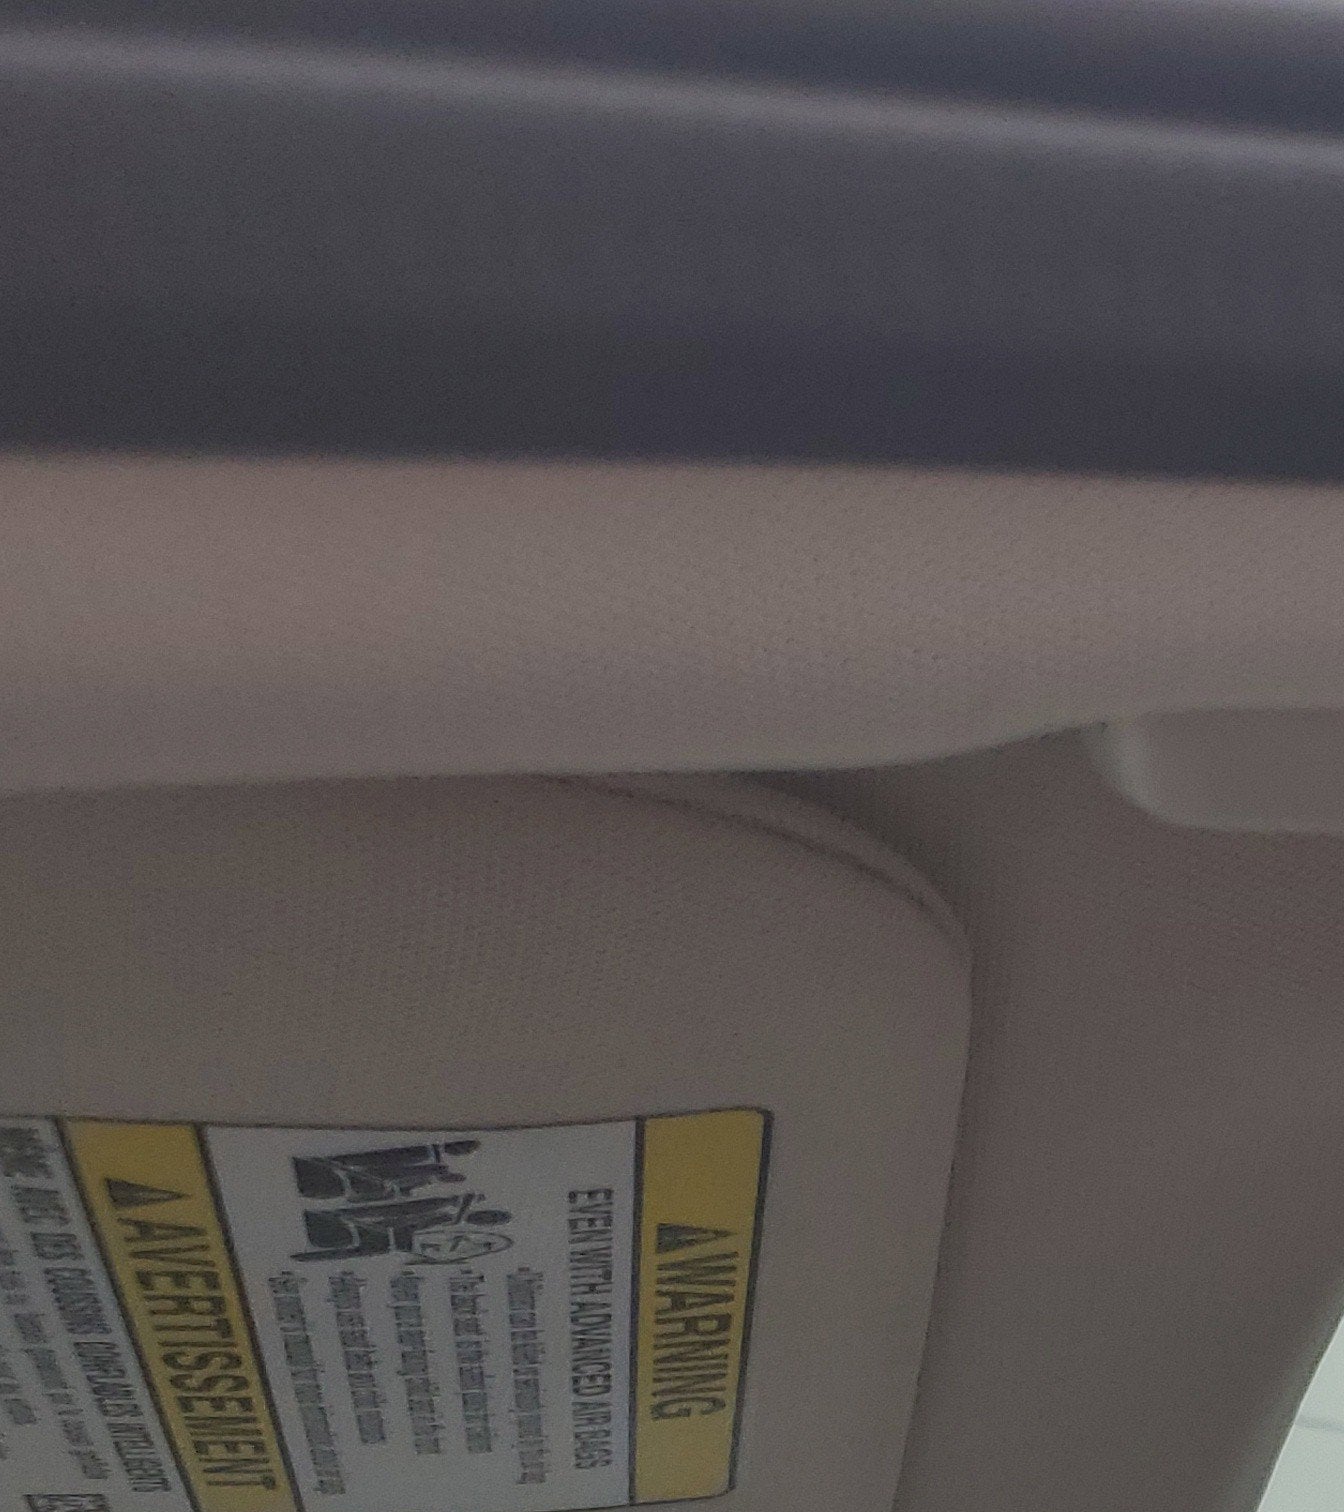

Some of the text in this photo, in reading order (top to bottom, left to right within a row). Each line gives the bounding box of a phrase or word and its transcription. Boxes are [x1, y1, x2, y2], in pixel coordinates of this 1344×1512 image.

[568, 1187, 614, 1244] EVEN
[570, 1245, 613, 1297] WITH
[117, 1216, 277, 1490] AVERTISSEMENT
[570, 1301, 613, 1398] ADVANCED
[650, 1251, 739, 1422] WARNING
